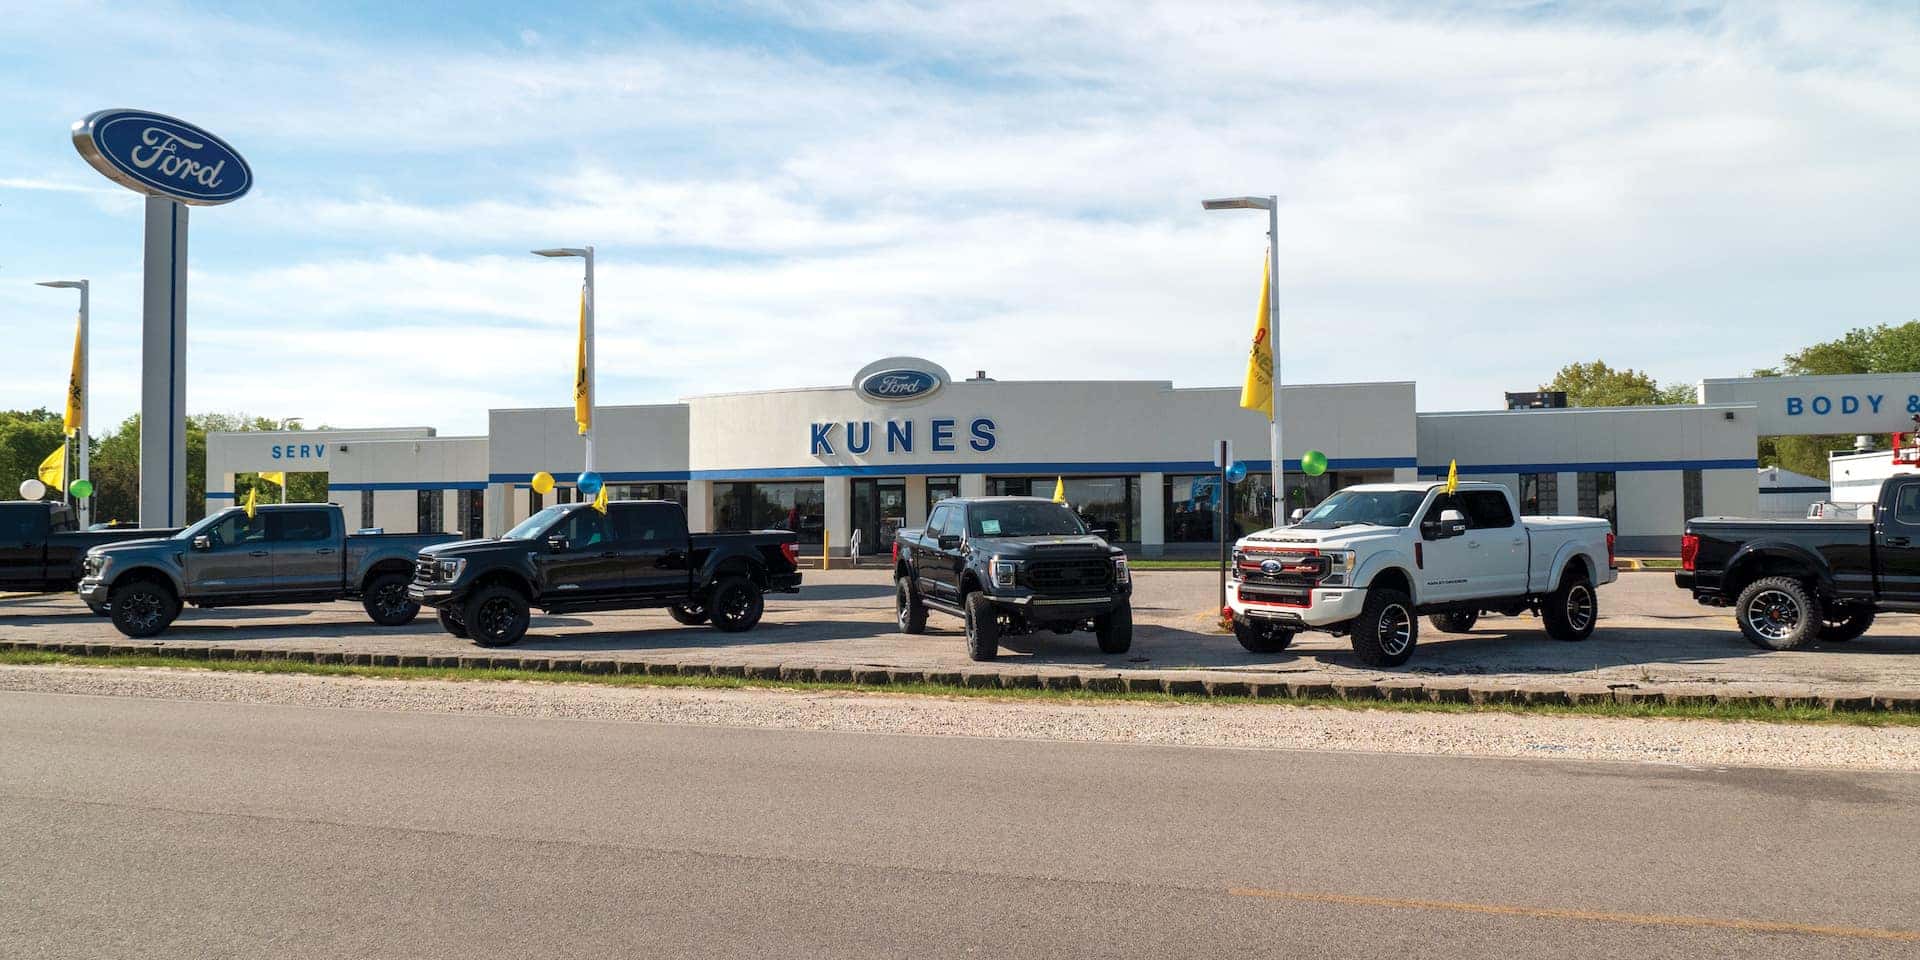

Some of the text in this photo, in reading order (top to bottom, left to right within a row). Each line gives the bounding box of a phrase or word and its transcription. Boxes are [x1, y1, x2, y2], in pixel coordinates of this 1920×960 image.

[131, 127, 225, 188] Ford
[878, 375, 920, 394] Ford
[1786, 395, 1884, 416] BODY
[810, 418, 997, 456] KUNES
[271, 444, 325, 459] SERV
